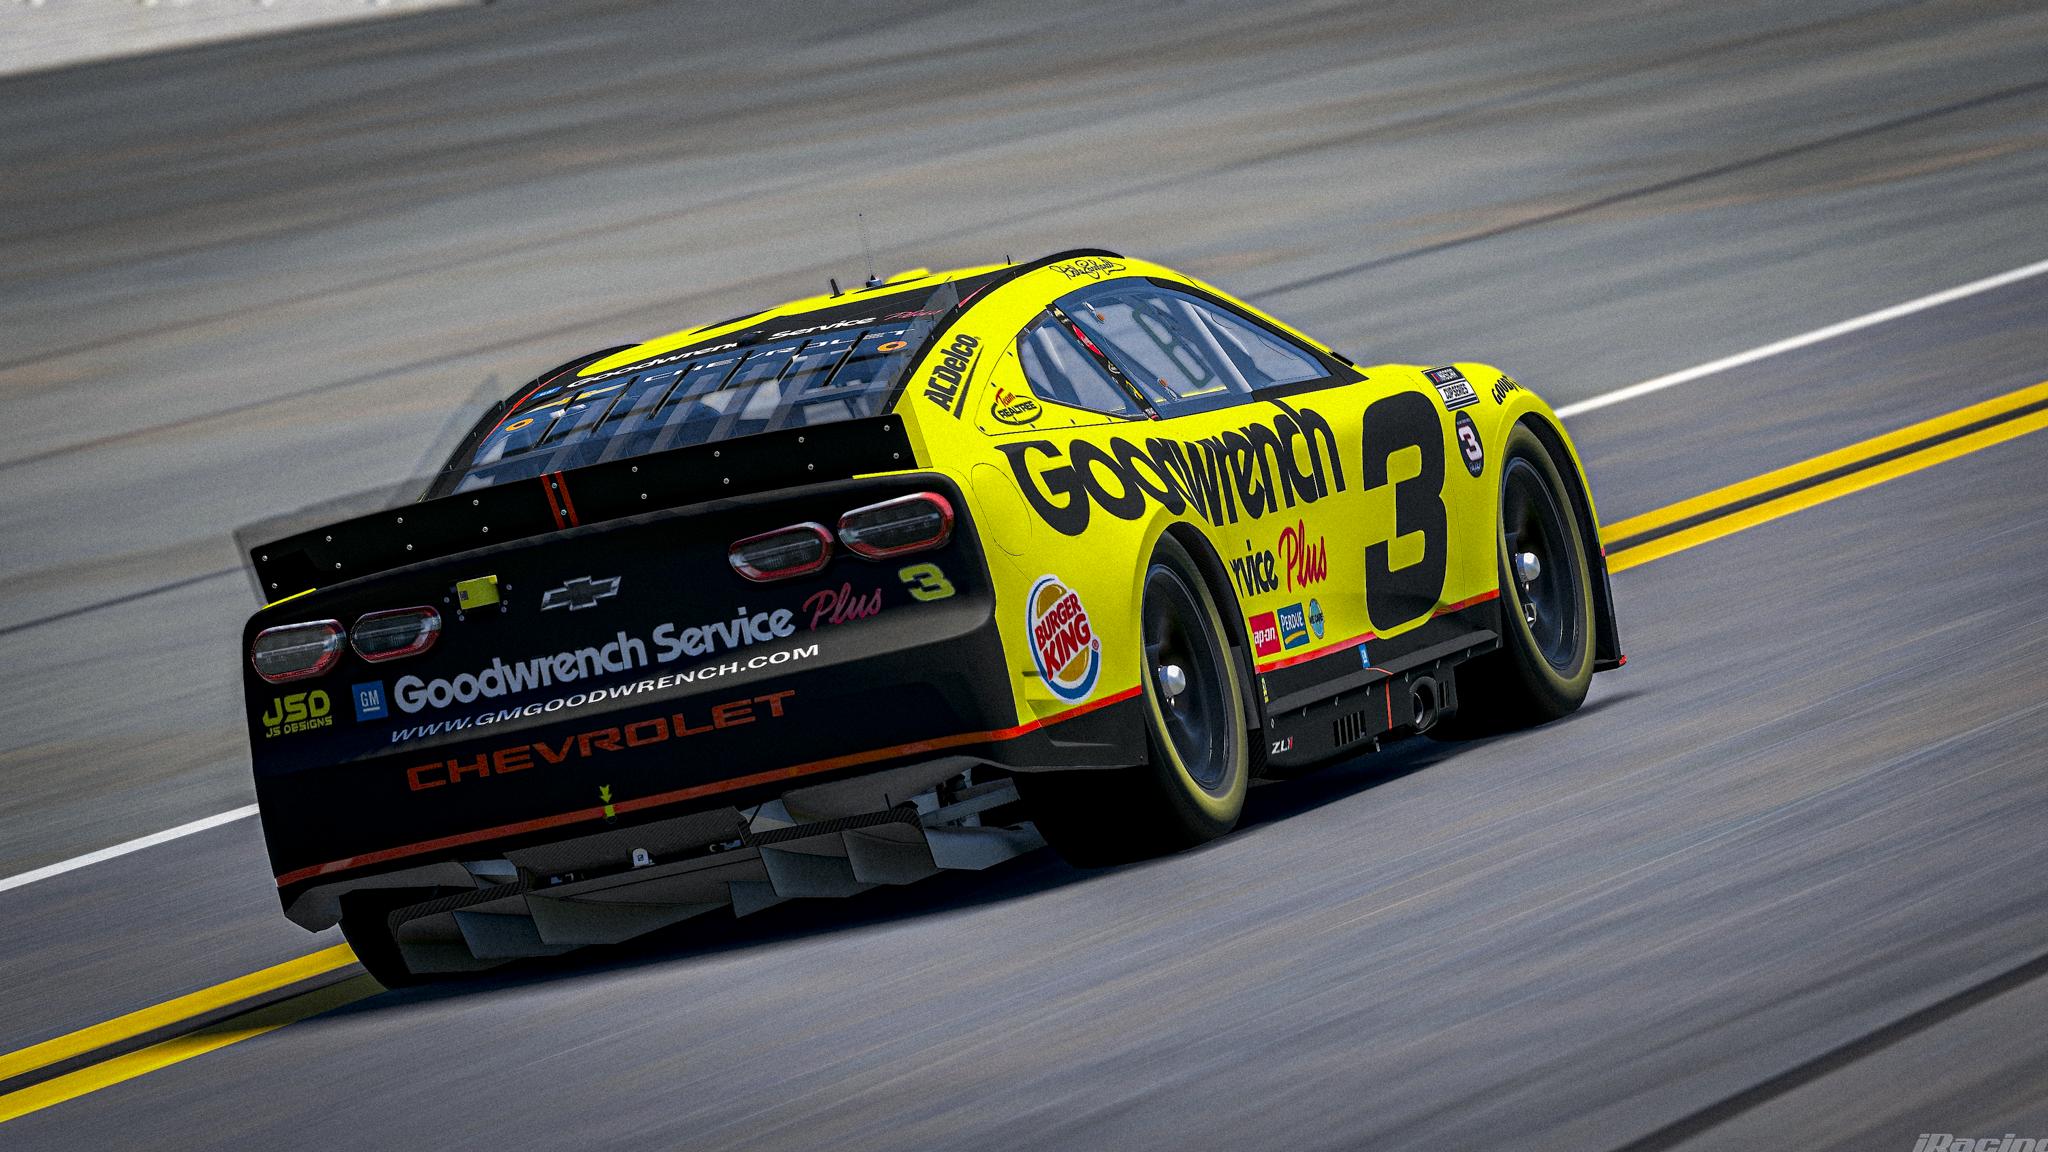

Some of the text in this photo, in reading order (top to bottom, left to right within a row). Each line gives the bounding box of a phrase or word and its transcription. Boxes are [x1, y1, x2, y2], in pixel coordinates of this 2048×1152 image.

[768, 317, 877, 341] Service
[924, 333, 979, 412] ACDelco
[997, 400, 1038, 419] REALTREE
[994, 399, 1347, 536] Goodwrench
[1458, 425, 1483, 462] 3
[1362, 390, 1448, 632] 3
[899, 562, 956, 602] 3
[1278, 518, 1328, 593] Plus
[394, 582, 882, 714] Goodwrench Service Plus
[1034, 593, 1082, 651] BURGER
[1042, 613, 1091, 681] KING
[1280, 610, 1304, 632] PERDUE
[262, 689, 331, 728] JSD
[360, 688, 379, 708] GM
[391, 644, 819, 743] WWW.GMGOODWRENCH.COM
[266, 715, 333, 738] JS DESIGNS
[407, 689, 796, 791] CHEVROLET
